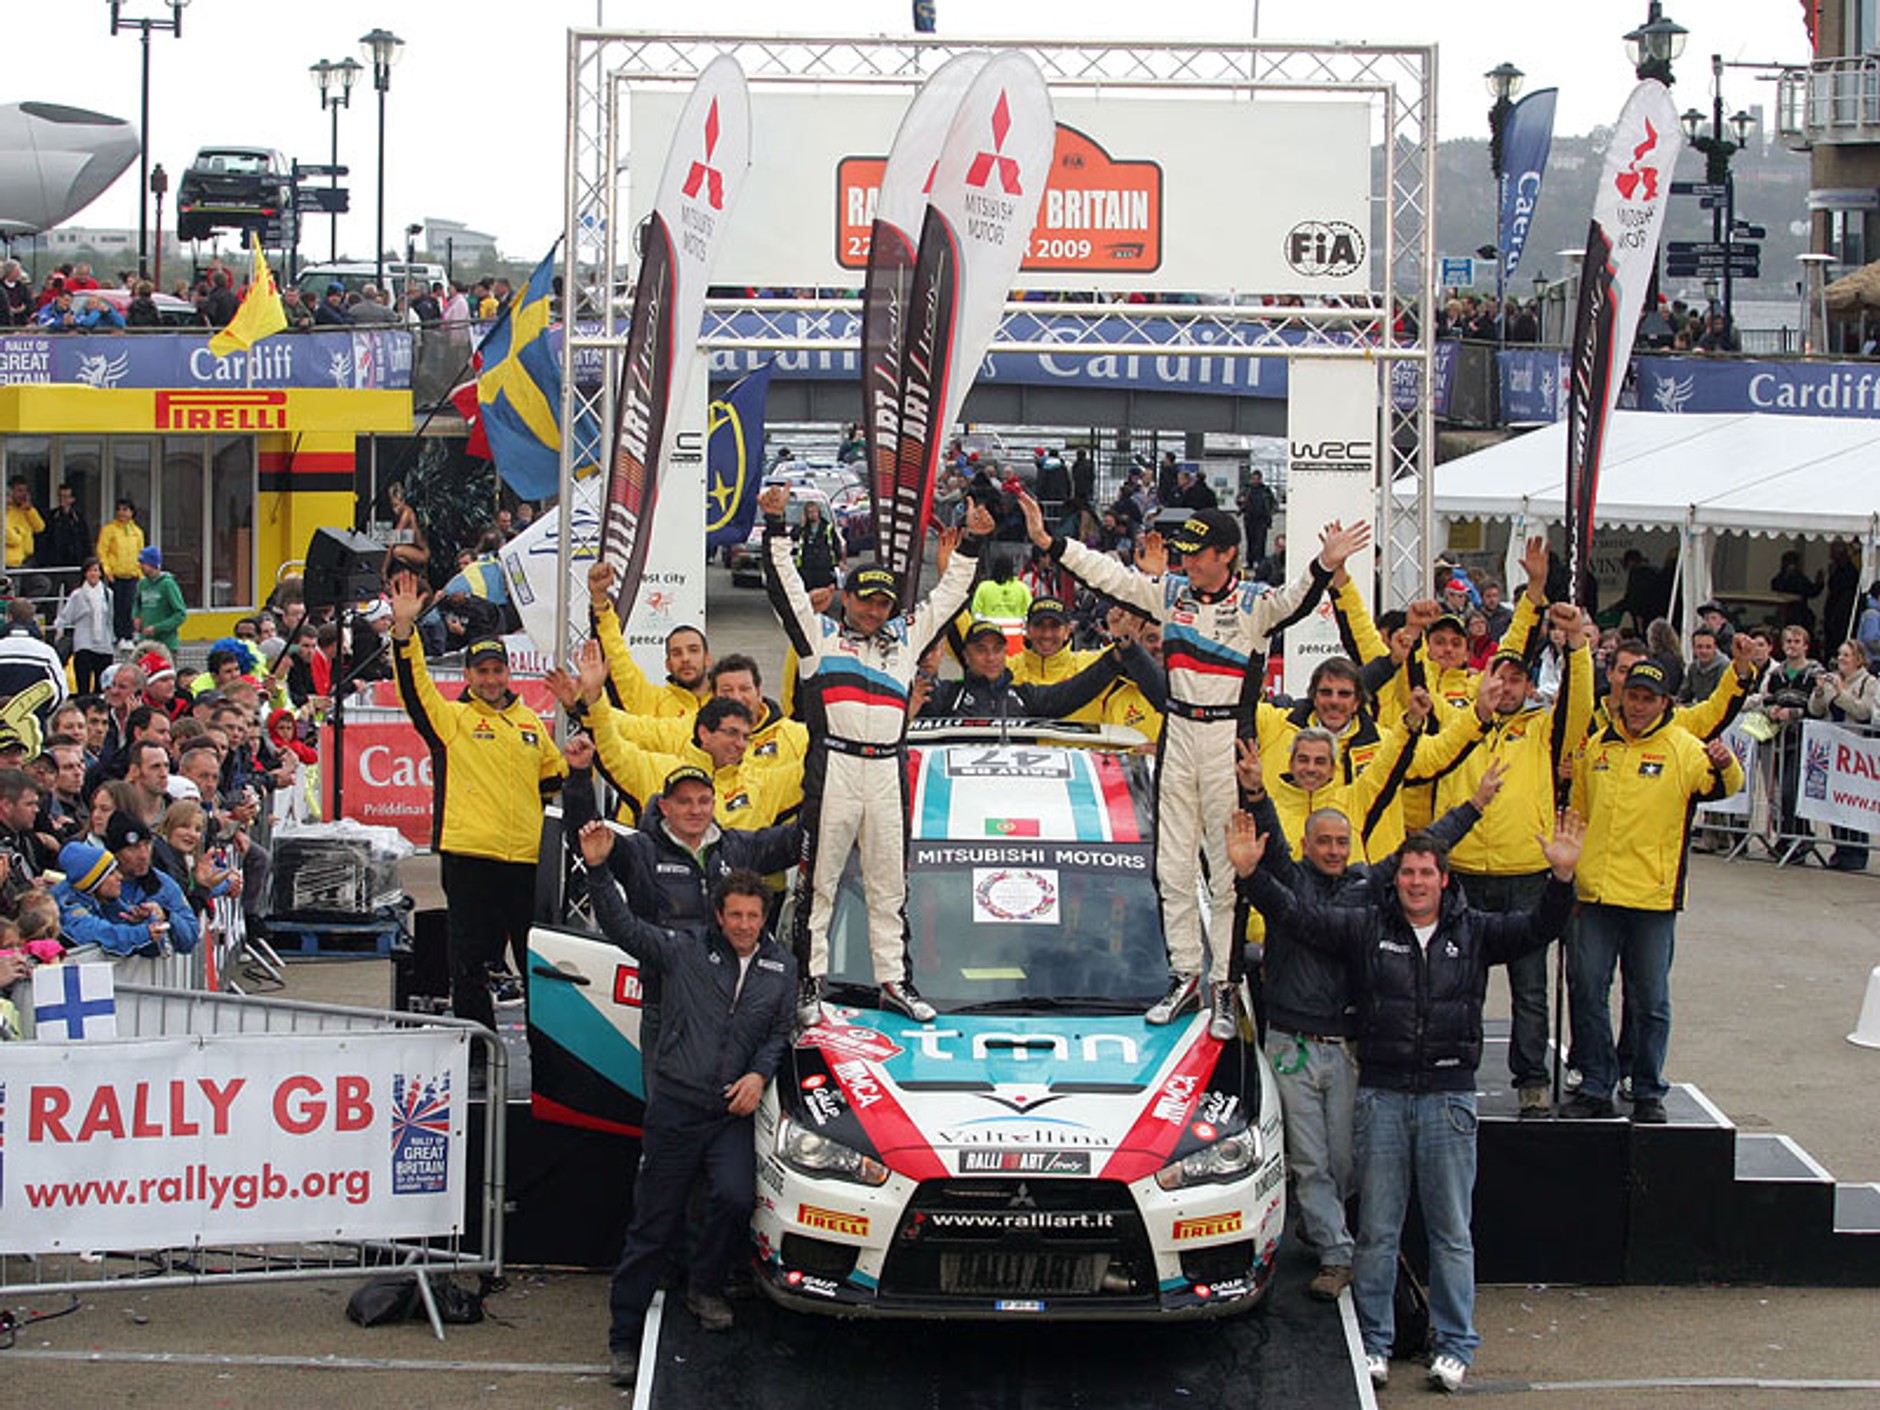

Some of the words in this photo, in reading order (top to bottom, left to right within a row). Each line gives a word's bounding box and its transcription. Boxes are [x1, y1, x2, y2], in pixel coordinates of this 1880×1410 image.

[1047, 189, 1149, 230] BRITAIN
[1036, 239, 1092, 259] 2009
[190, 344, 293, 381] Cardiff
[155, 390, 287, 430] PIRELLI
[620, 389, 650, 464] ART
[902, 376, 929, 443] ART
[1291, 441, 1372, 459] WRC
[918, 849, 1045, 864] MITSUBISHI
[1055, 851, 1146, 869] MOTORS
[901, 1025, 1138, 1063] tmn
[28, 1077, 246, 1143] RALLY
[272, 1075, 375, 1135] GB
[404, 1147, 445, 1160] GREAT
[938, 1130, 1110, 1146] Valtellina
[395, 1161, 446, 1175] BRITAIN
[25, 1163, 370, 1210] www.rallygb.org
[797, 1203, 869, 1237] PIRELLI
[933, 1213, 1113, 1228] www.ralliart.it
[1172, 1210, 1242, 1240] PIRELLI
